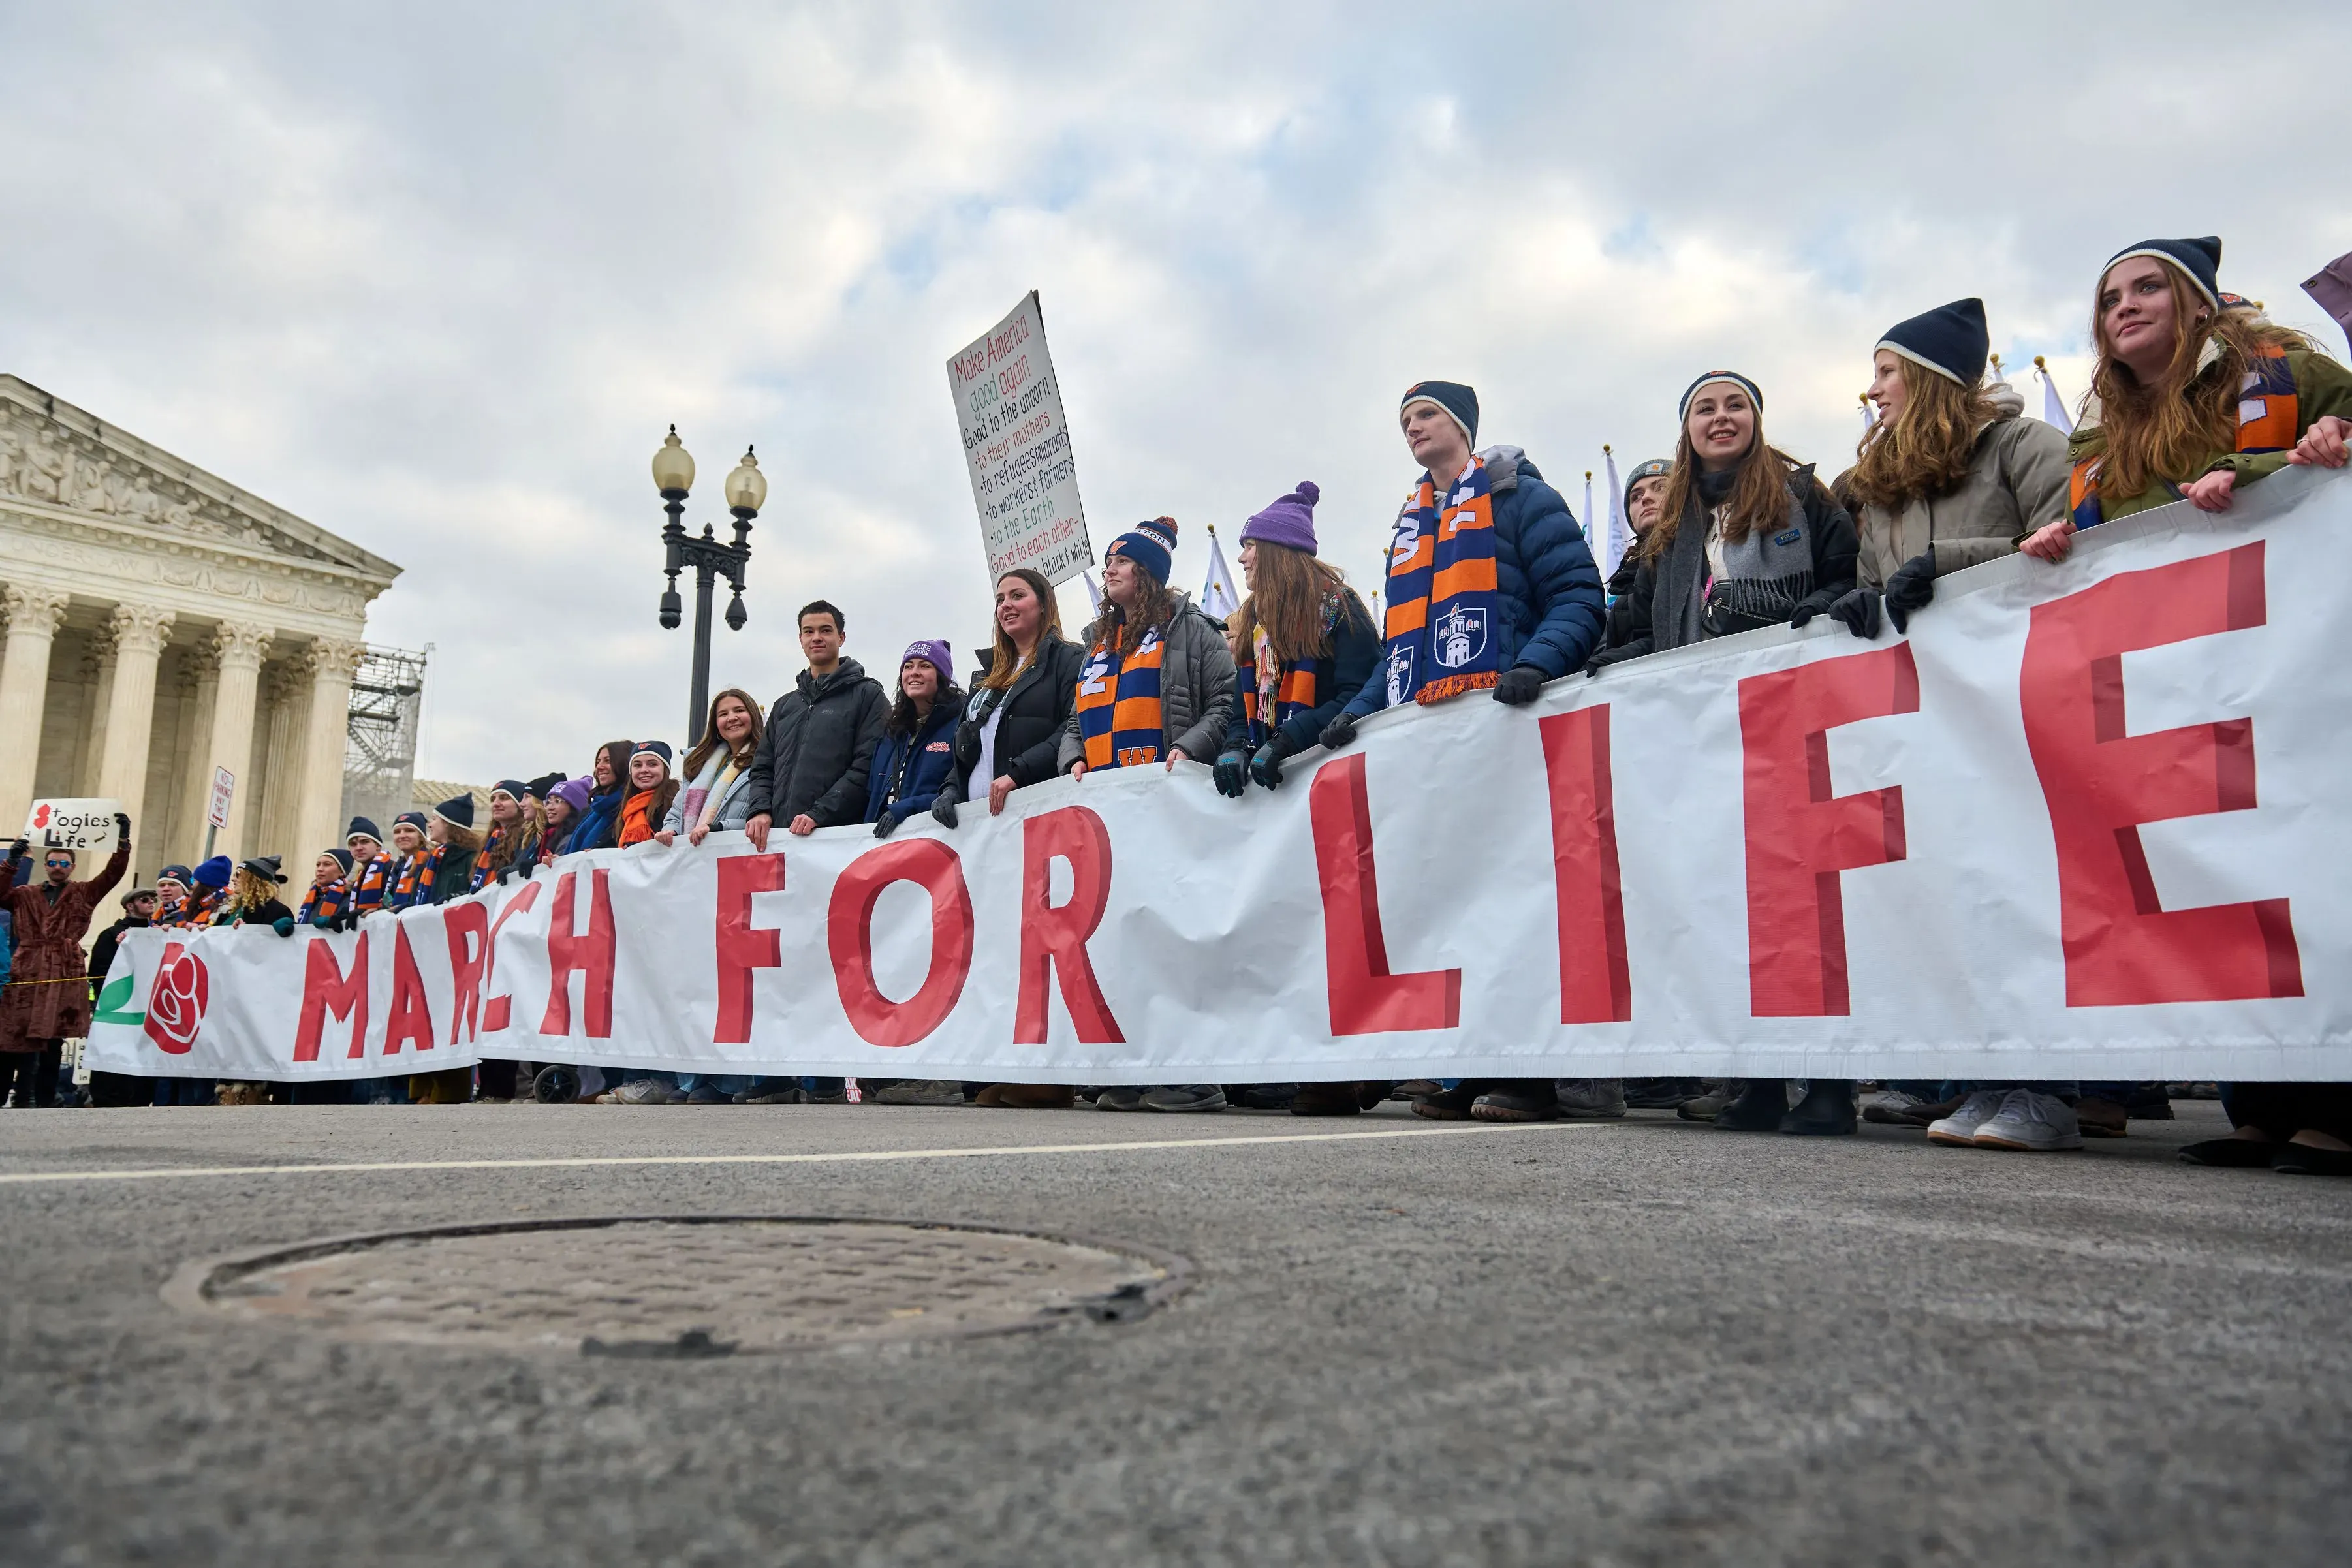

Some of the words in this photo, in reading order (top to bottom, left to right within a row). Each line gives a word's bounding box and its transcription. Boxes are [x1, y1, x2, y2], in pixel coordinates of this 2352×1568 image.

[954, 350, 986, 388] Make
[987, 314, 1029, 368] America
[964, 418, 988, 449] Good
[988, 413, 1000, 434] to
[1000, 400, 1018, 427] the
[1019, 376, 1050, 415] unborn
[970, 373, 999, 422] good
[999, 354, 1031, 399] again
[977, 450, 987, 470] to
[987, 437, 1011, 463] their
[1012, 411, 1050, 448] mothers
[982, 475, 993, 495] to
[987, 501, 997, 522] to
[998, 482, 1034, 515] workers
[1039, 456, 1074, 494] farmers
[992, 526, 1003, 546] to
[1004, 516, 1020, 540] the
[1022, 495, 1055, 530] Earth
[1780, 532, 1795, 541] POLO
[12, 537, 86, 564] UNDER
[990, 544, 1016, 574] Good
[1016, 541, 1027, 563] to
[1027, 528, 1051, 557] each
[1041, 549, 1067, 578] black
[1064, 546, 1070, 566] &
[1070, 536, 1090, 564] white
[293, 868, 616, 1062] MARCH
[713, 805, 1127, 1047] FOR
[1309, 539, 2306, 1036] LIFE
[44, 829, 86, 849] Life
